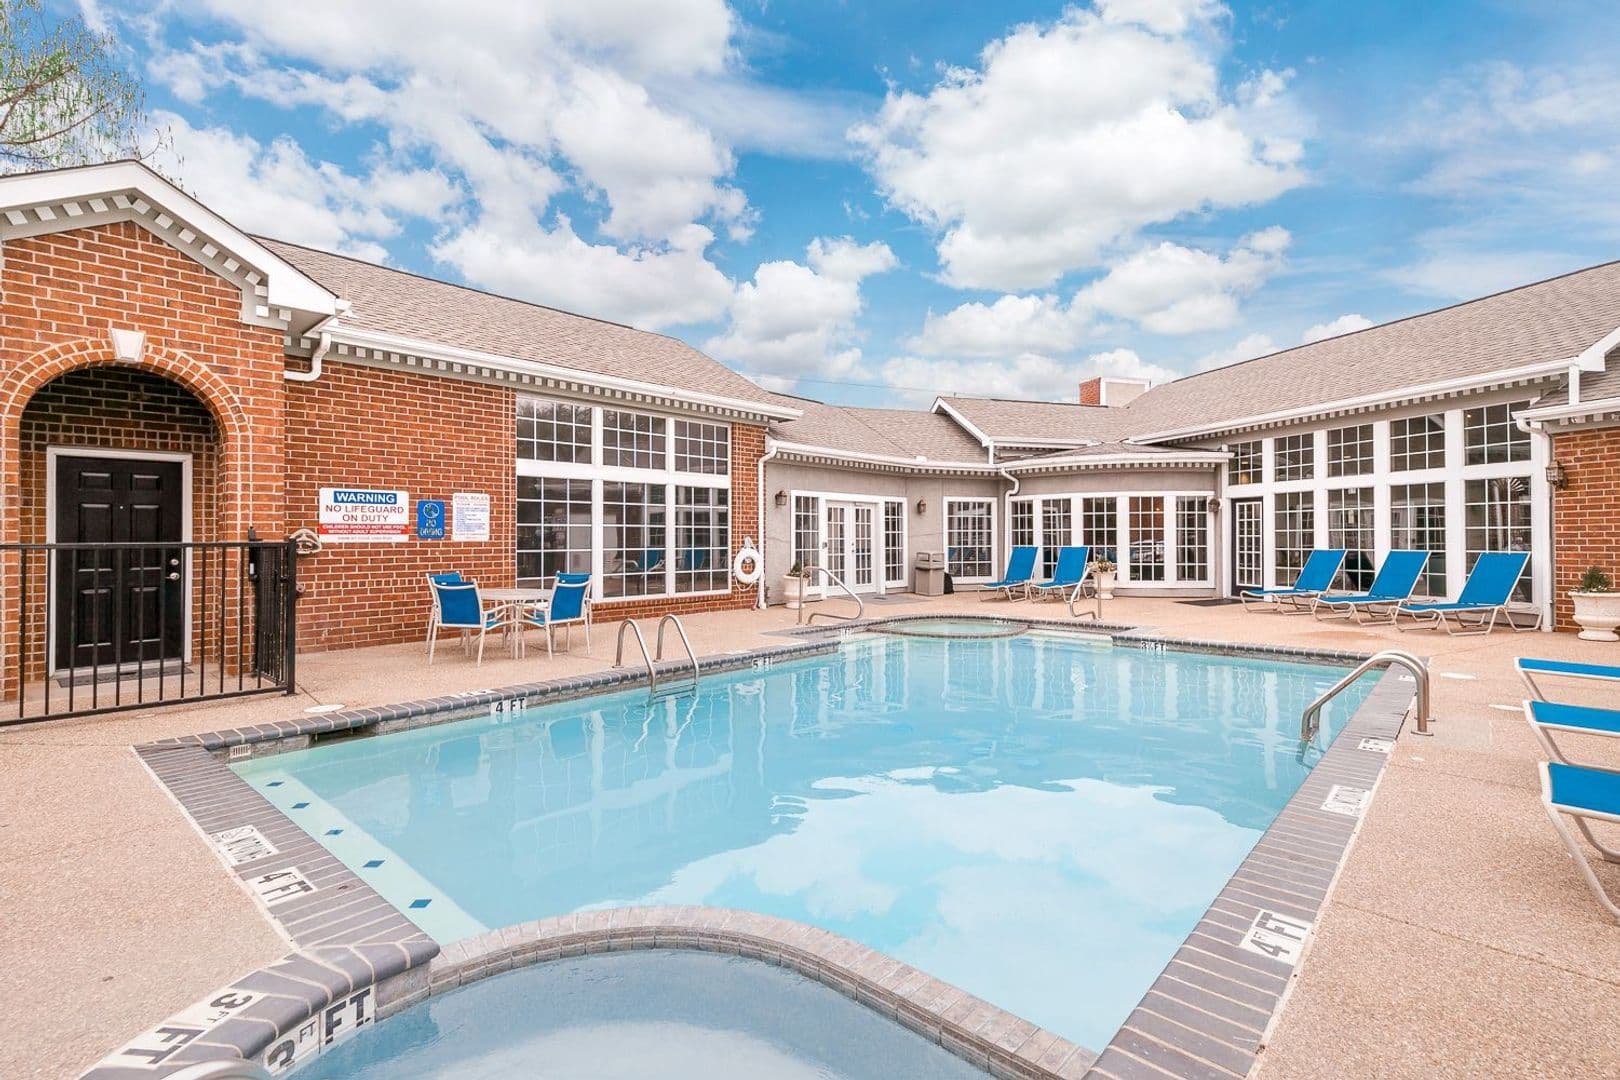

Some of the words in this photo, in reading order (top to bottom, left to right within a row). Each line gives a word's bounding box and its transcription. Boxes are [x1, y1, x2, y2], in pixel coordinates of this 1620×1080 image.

[335, 492, 395, 503] WARNING
[325, 504, 342, 513] NO
[345, 505, 404, 514] LIFEGUARD
[342, 514, 358, 522] ON
[361, 514, 389, 522] DUTY
[495, 701, 504, 713] 4
[510, 698, 525, 711] FT
[258, 872, 292, 884] 4
[261, 879, 314, 902] FT
[1255, 911, 1307, 941] FT
[1250, 938, 1290, 957] 4
[210, 992, 253, 1009] 3
[121, 1027, 206, 1065] FT
